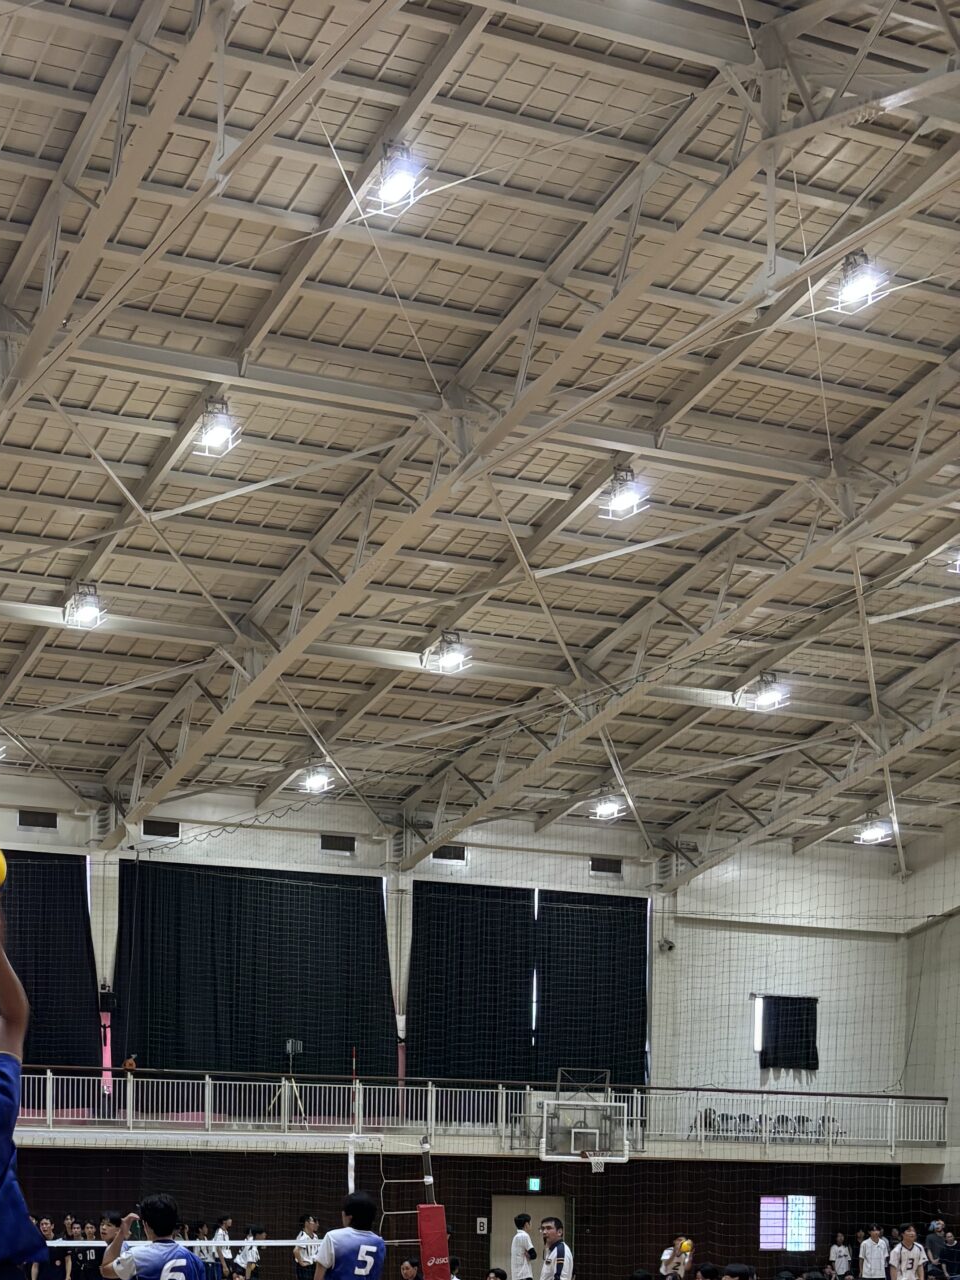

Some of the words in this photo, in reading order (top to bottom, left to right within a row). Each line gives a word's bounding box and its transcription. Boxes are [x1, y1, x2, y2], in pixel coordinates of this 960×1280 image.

[479, 1221, 485, 1232] B
[87, 1249, 96, 1261] 10
[354, 1245, 377, 1276] 5
[906, 1258, 915, 1270] 3
